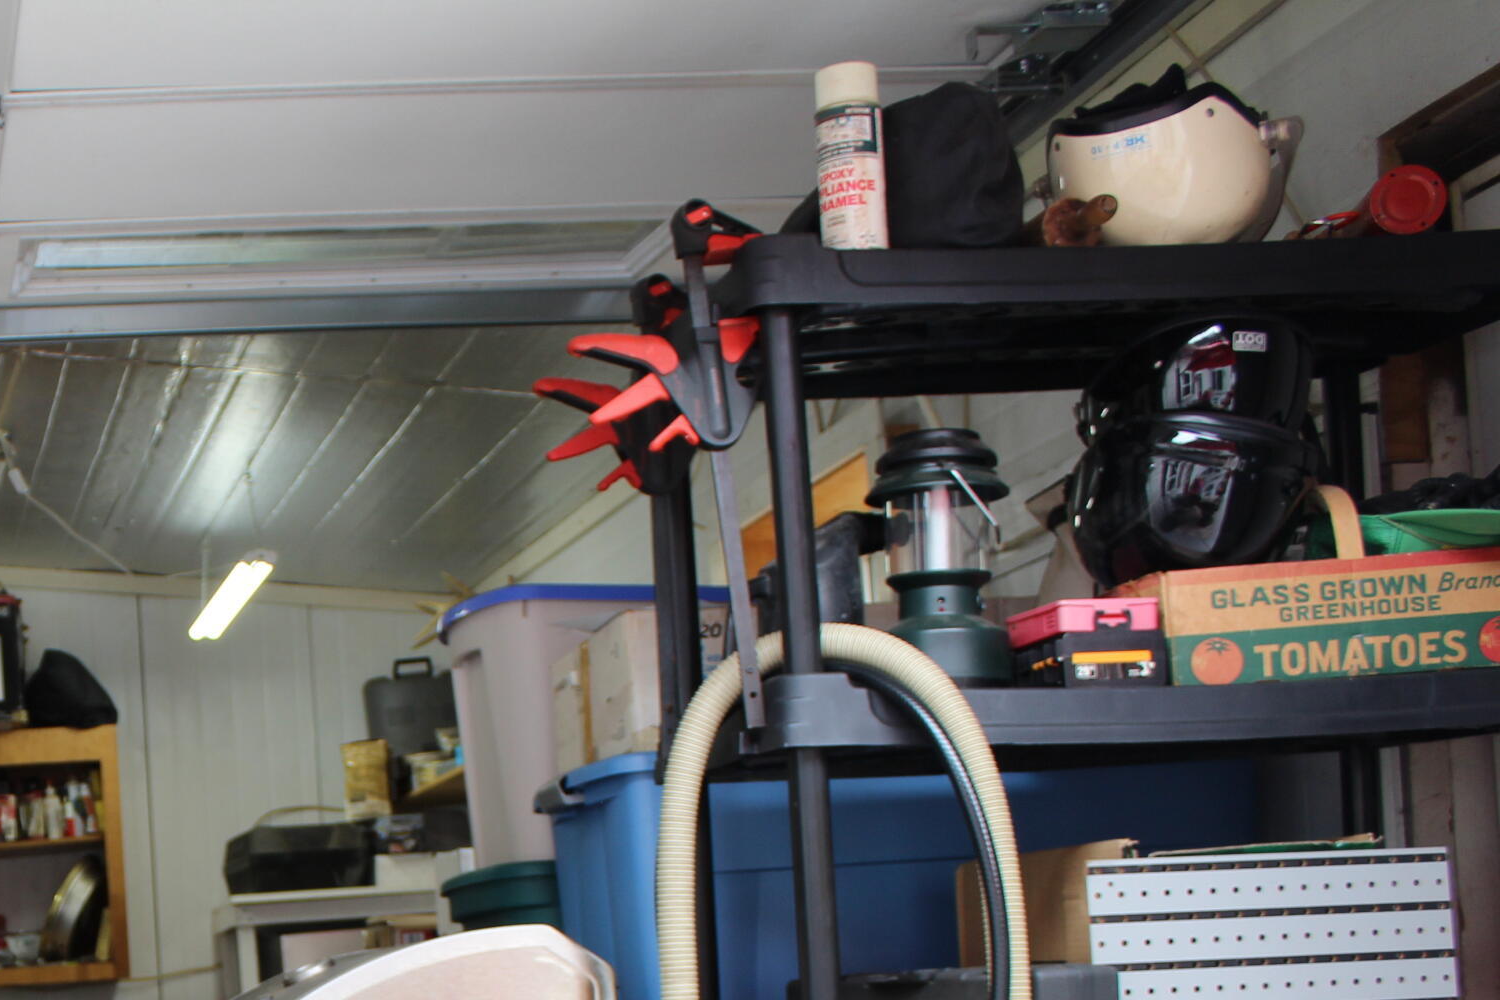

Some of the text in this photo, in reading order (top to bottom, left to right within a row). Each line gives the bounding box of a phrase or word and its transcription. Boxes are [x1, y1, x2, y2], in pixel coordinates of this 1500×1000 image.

[1211, 583, 1310, 609] GLASS
[1320, 573, 1427, 601] GROWN
[1280, 594, 1442, 622] GREENHOUSE
[1253, 629, 1467, 678] TOMATOES
